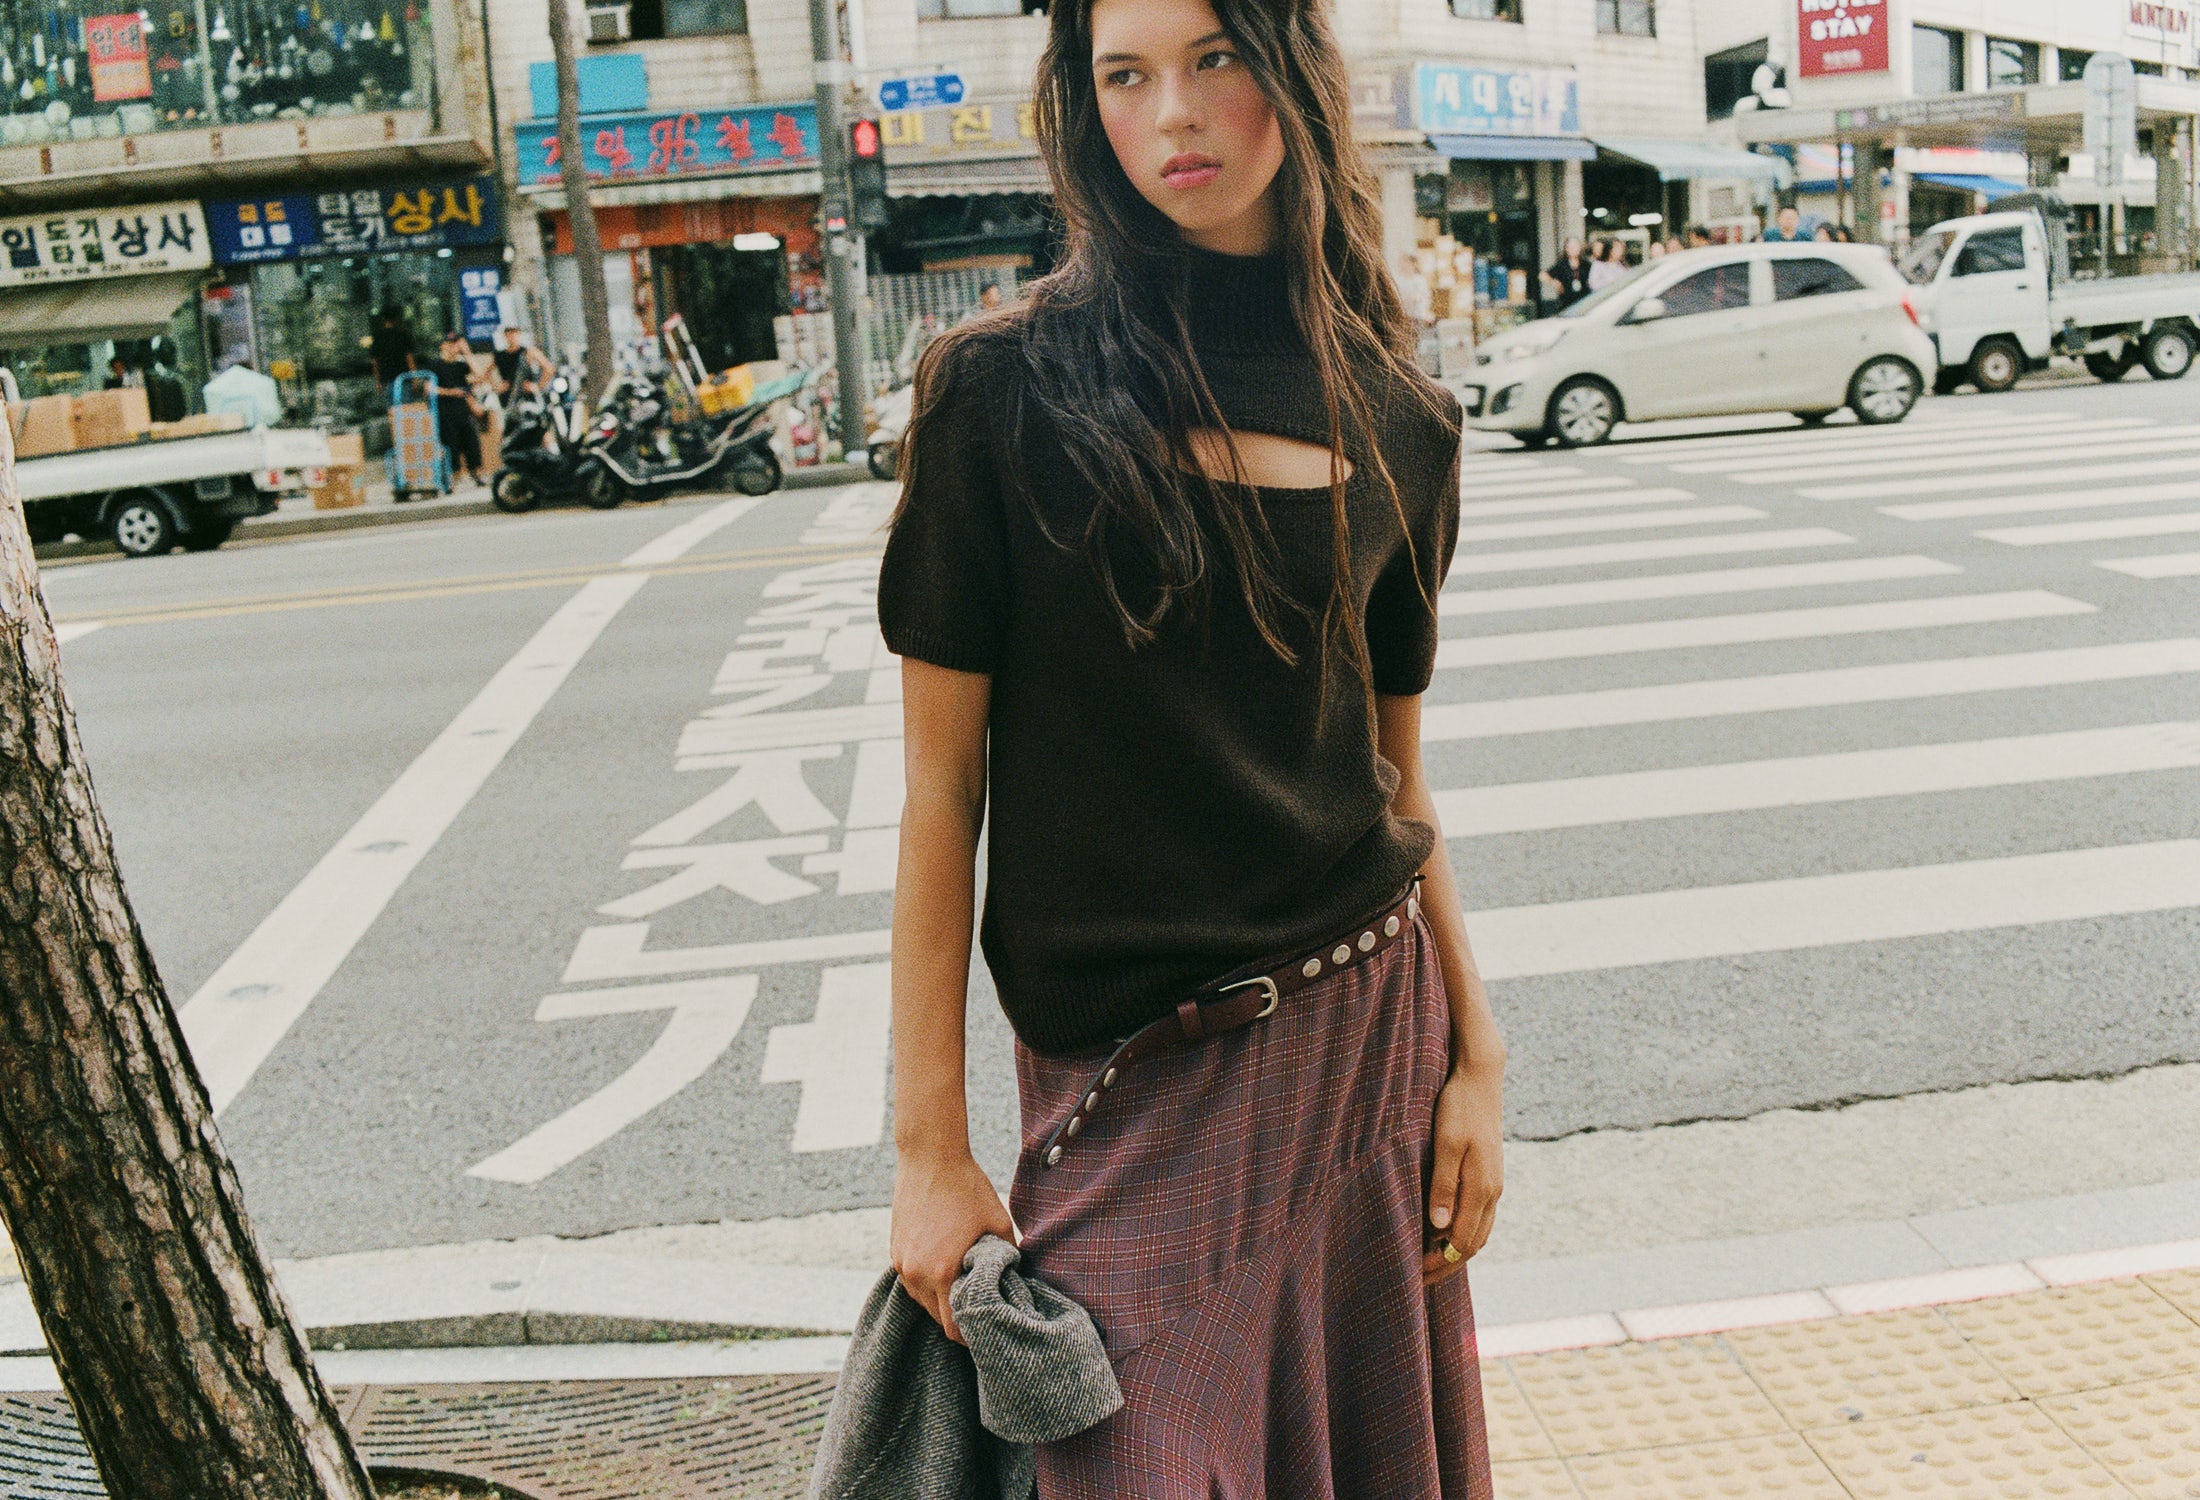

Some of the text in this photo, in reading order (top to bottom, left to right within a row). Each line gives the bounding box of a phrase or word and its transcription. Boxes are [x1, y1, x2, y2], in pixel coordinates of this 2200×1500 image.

[1809, 13, 1873, 41] STAY
[387, 184, 484, 234] 상사
[45, 217, 100, 241] 도기
[111, 212, 194, 258] 상사
[322, 216, 386, 248] 도기
